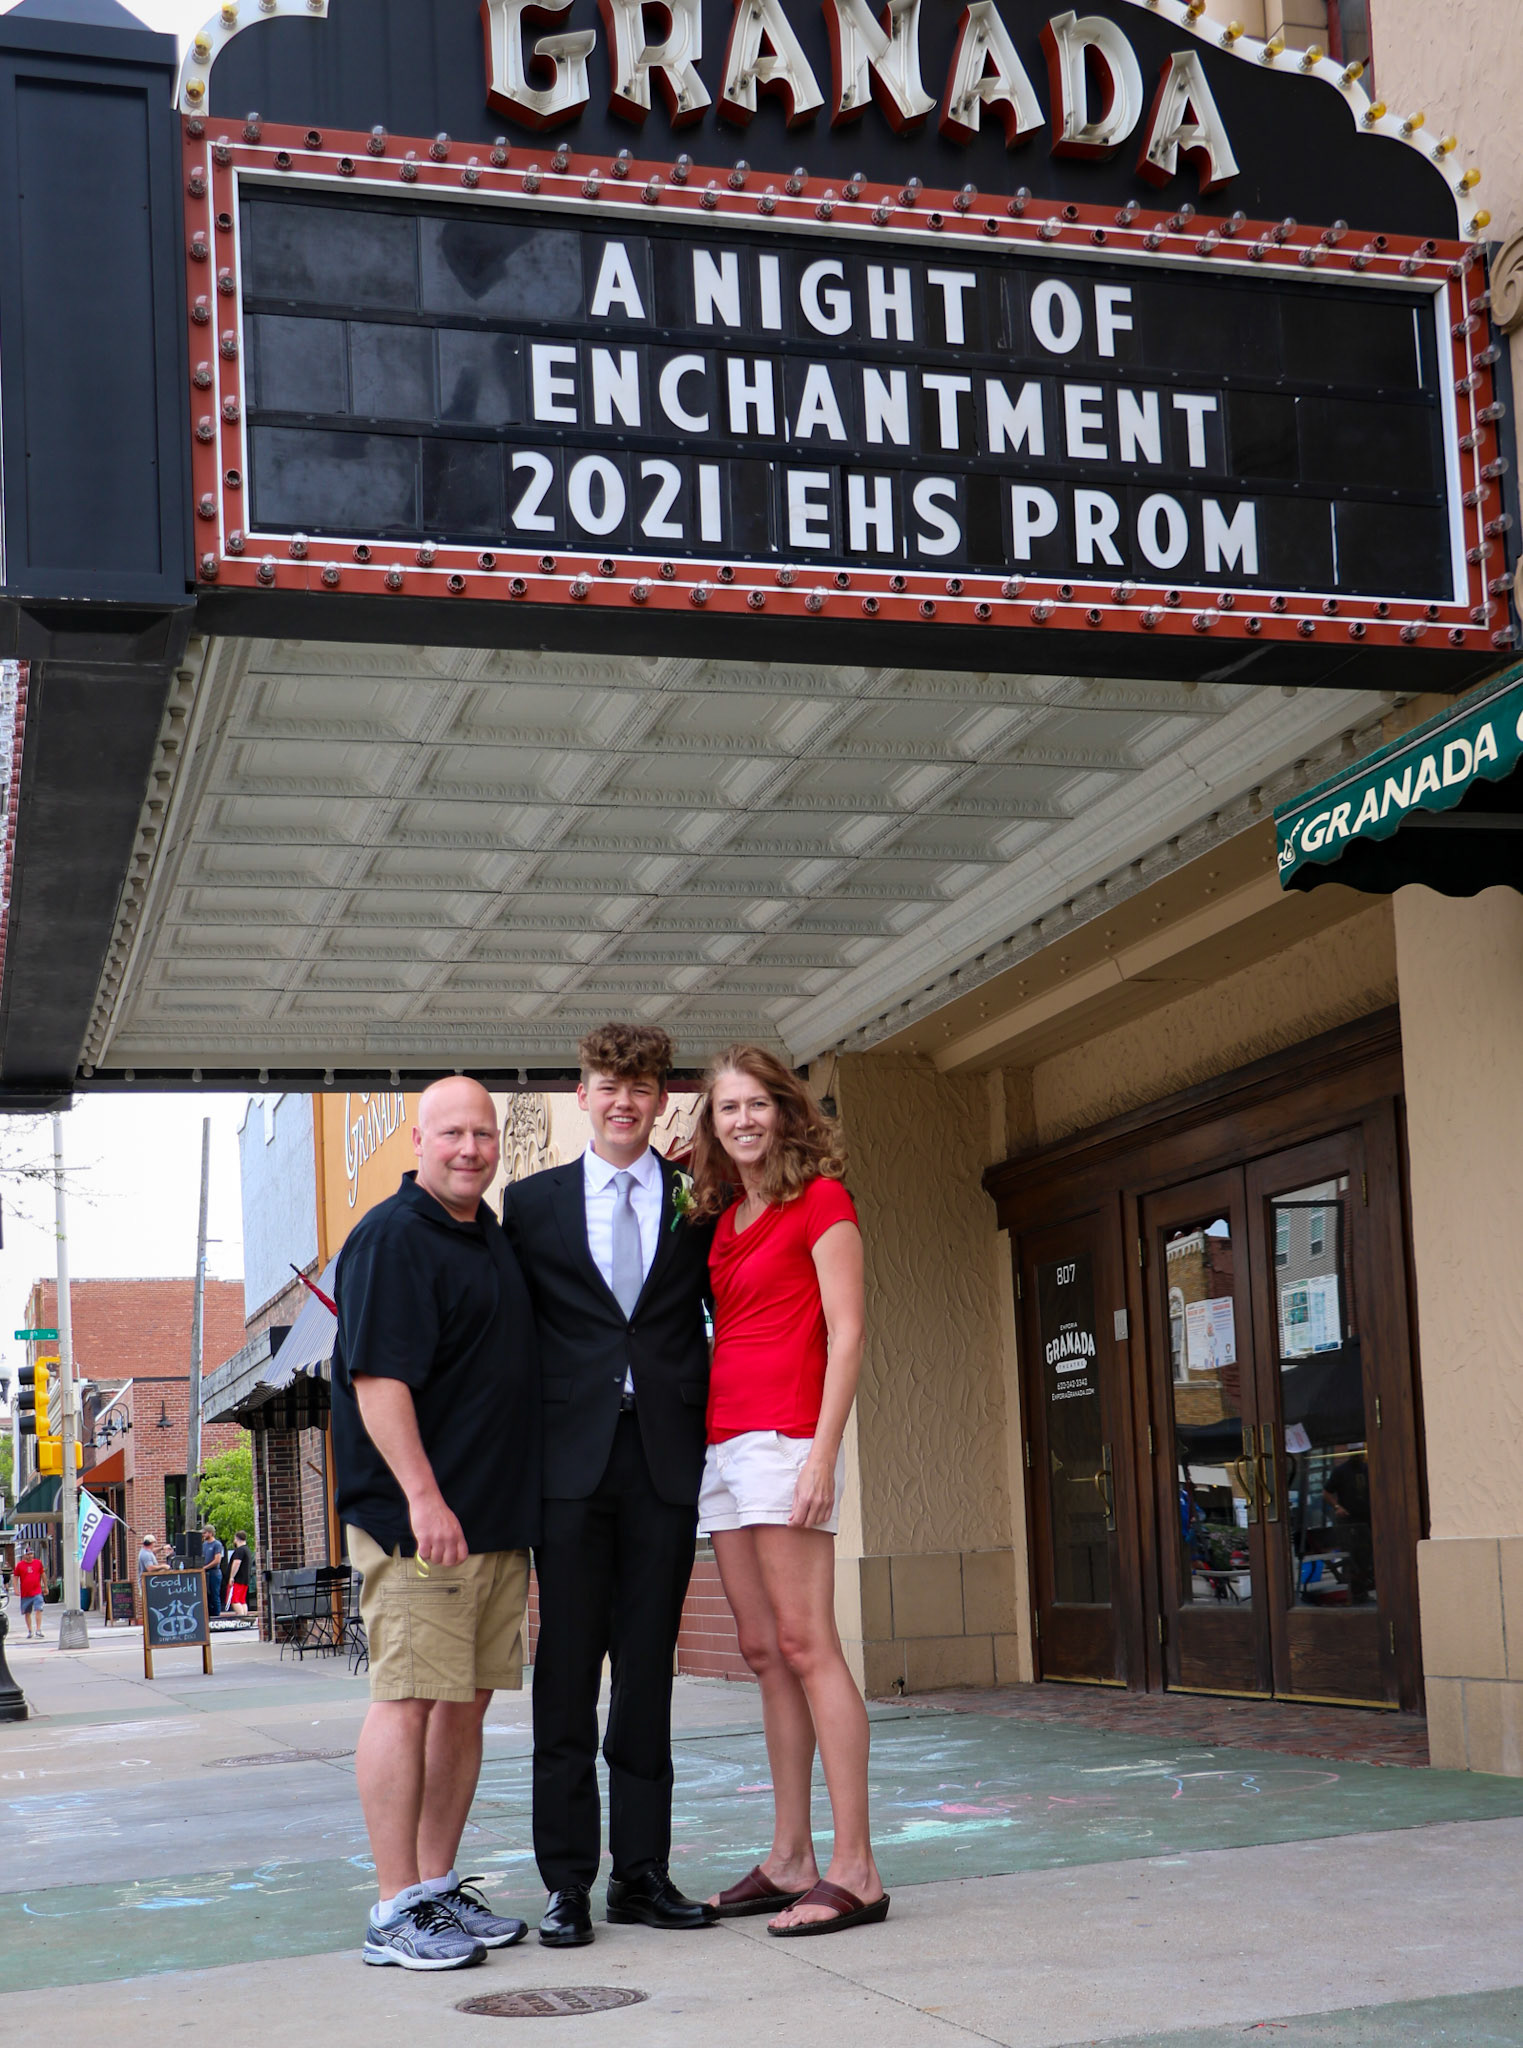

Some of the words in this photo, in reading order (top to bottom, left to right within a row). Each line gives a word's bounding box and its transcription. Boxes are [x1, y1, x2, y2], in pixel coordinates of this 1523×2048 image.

[482, 0, 1241, 193] GRANADA
[590, 242, 646, 319] A
[693, 249, 976, 344] NIGHT
[1030, 280, 1133, 357] OF
[531, 344, 1217, 468] ENCHANTMENT
[511, 451, 722, 542] 2021
[787, 470, 961, 556] EHS
[1011, 485, 1258, 575] PROM
[1300, 722, 1499, 852] GRANADA
[1056, 1263, 1076, 1286] 807
[1045, 1331, 1096, 1365] GRANADA
[149, 1575, 181, 1588] Good
